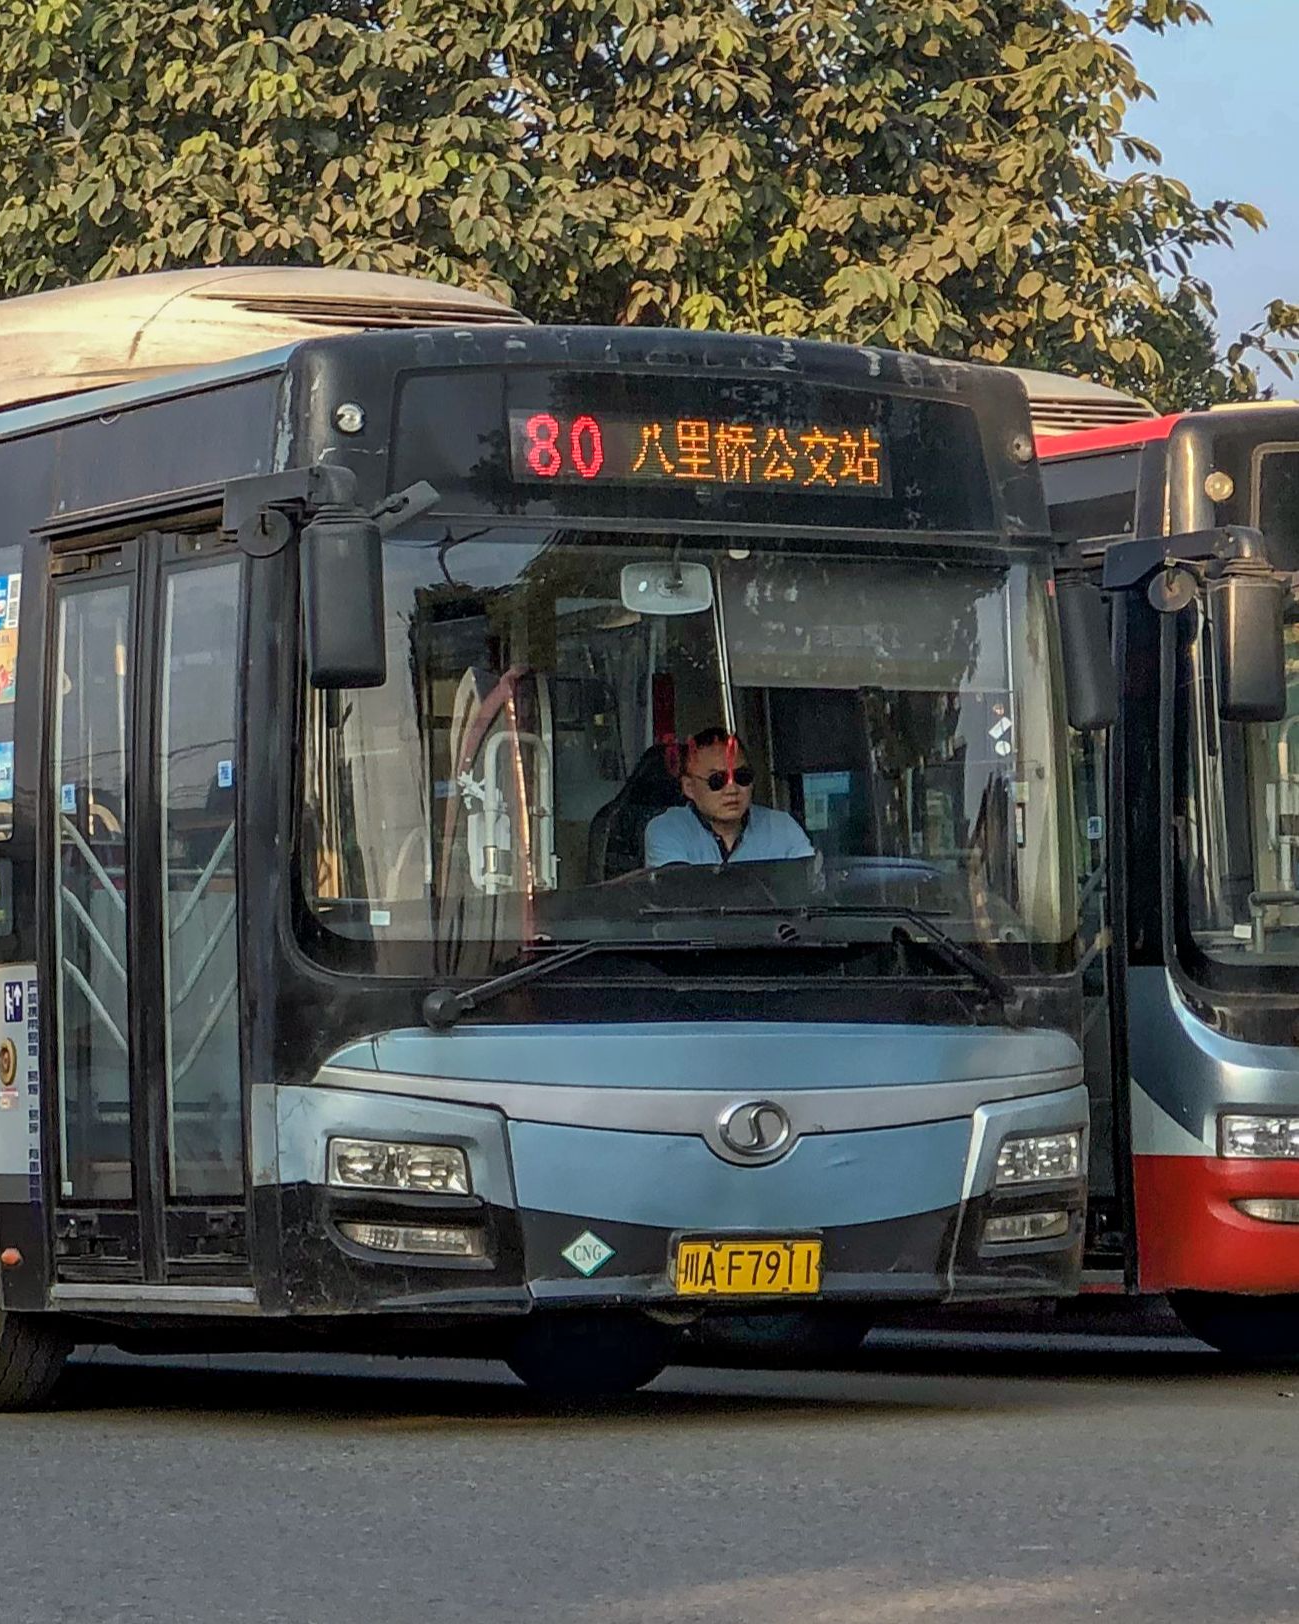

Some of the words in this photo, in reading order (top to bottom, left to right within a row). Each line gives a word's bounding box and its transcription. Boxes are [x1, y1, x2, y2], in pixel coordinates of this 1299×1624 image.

[526, 414, 603, 478] 80
[633, 420, 880, 487] 八里桥公交站
[573, 1243, 602, 1260] CNG
